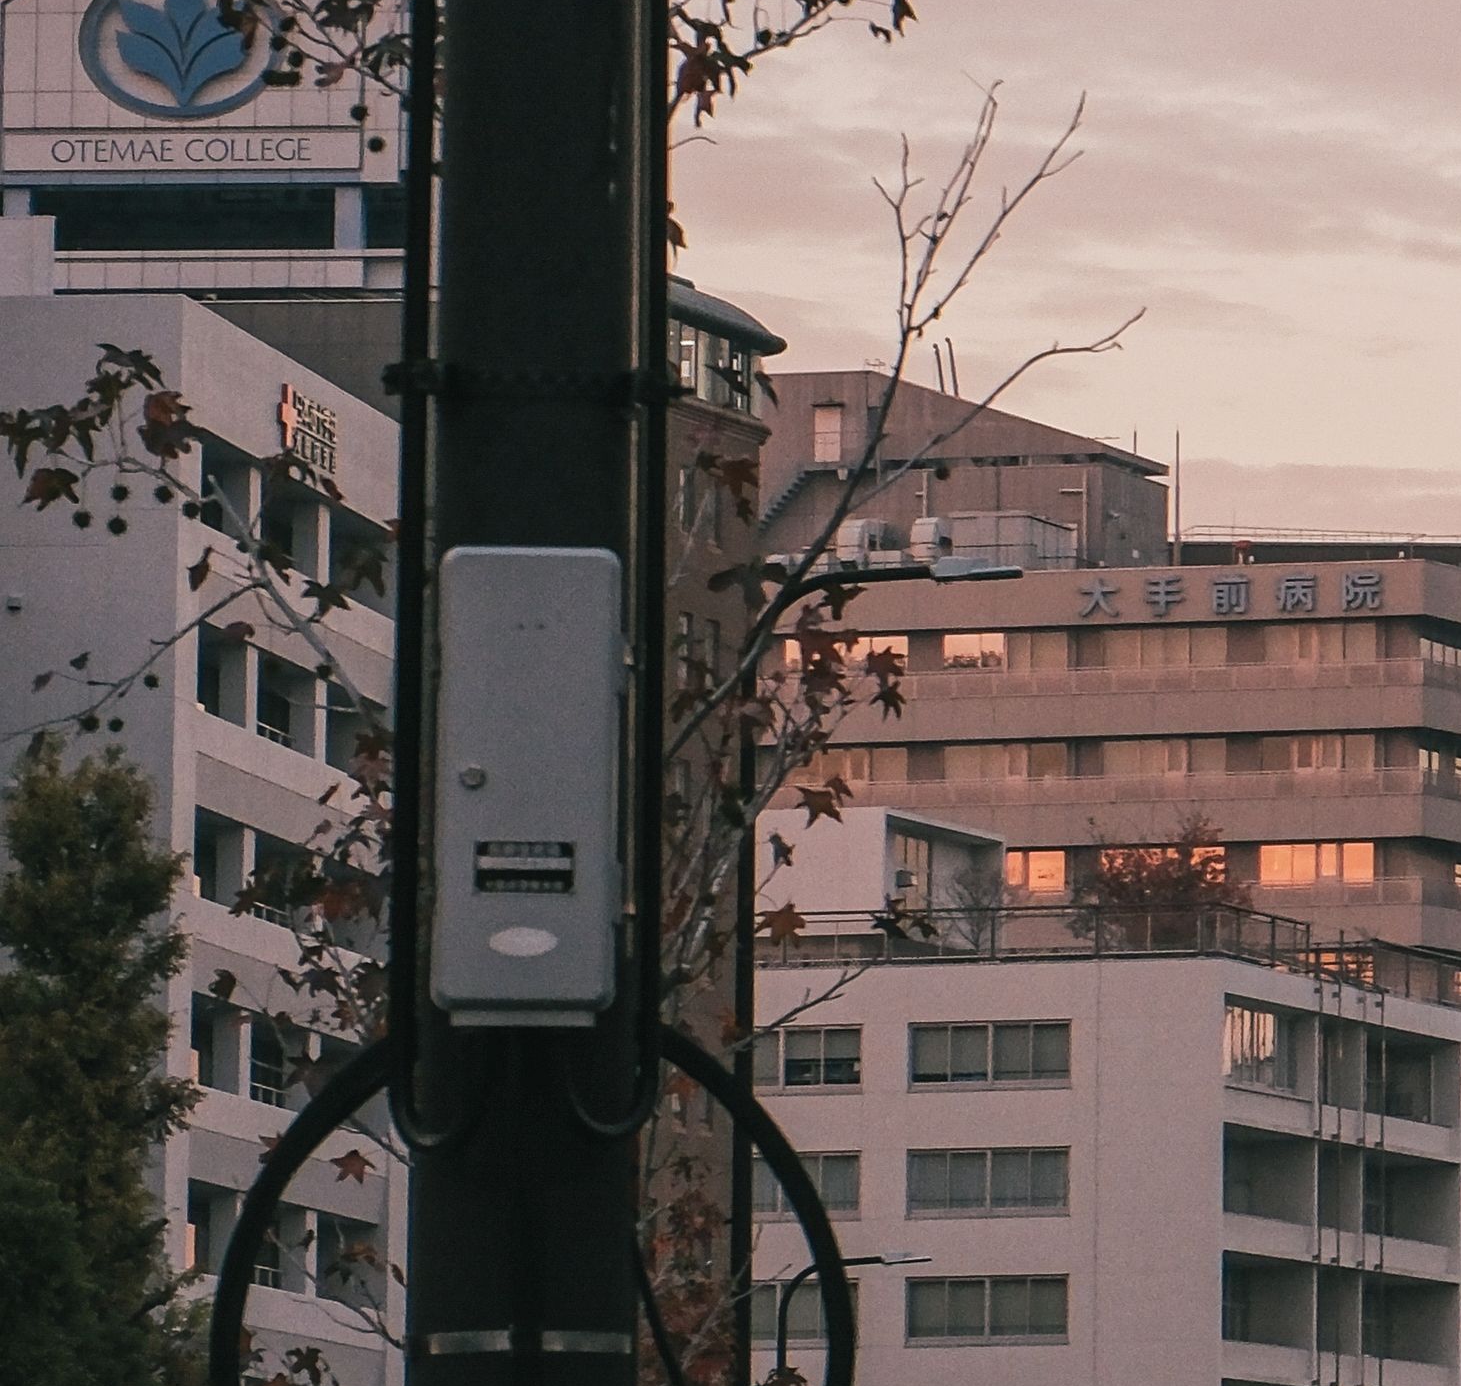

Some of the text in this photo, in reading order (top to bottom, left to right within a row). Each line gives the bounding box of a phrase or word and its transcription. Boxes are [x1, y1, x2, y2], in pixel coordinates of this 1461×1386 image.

[51, 138, 312, 162] OTEMAE COLLEGE
[1080, 571, 1382, 617] 大手前病院
